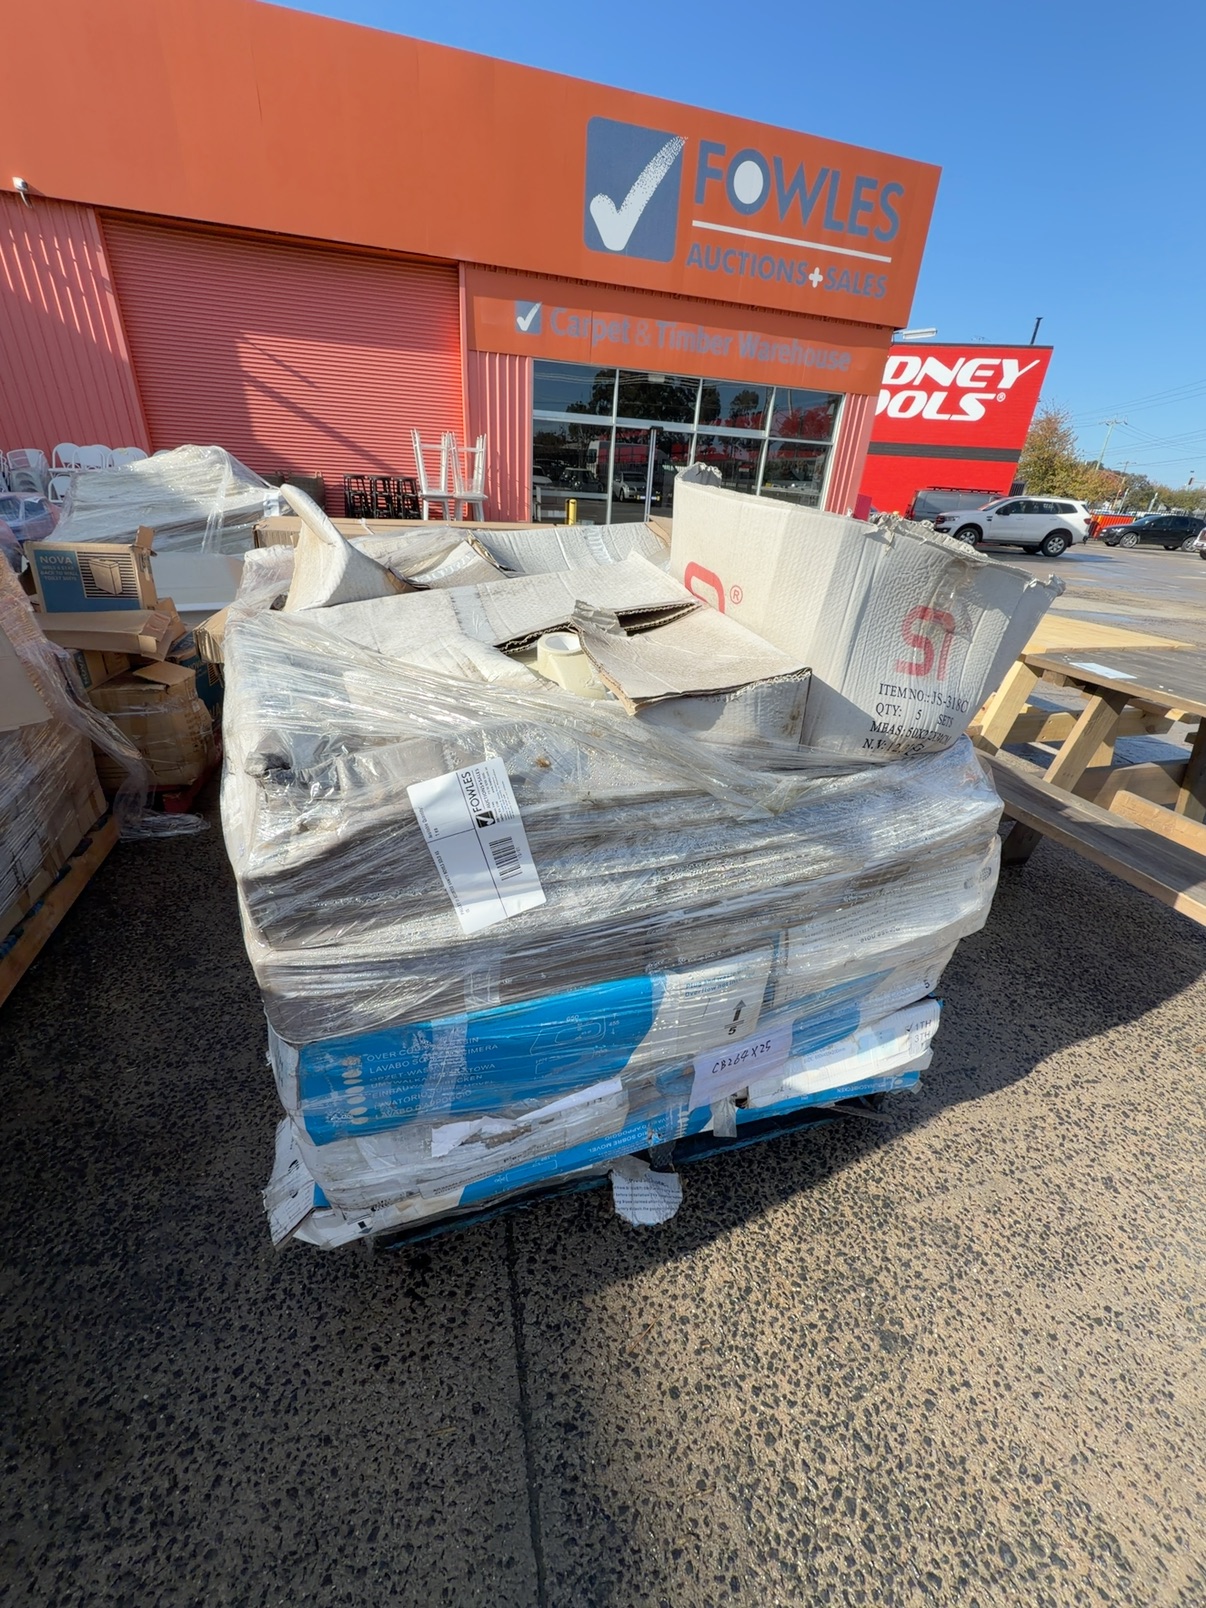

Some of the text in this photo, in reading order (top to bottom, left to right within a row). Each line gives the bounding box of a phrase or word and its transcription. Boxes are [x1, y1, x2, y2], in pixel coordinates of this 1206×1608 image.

[694, 139, 905, 243] FOWLES
[550, 307, 852, 372] Carpet & Timber Warehouse
[881, 354, 1041, 390] DNEY
[39, 555, 74, 566] NOVA
[879, 683, 907, 699] ITEM
[875, 702, 902, 717] QTY:
[916, 709, 922, 720] 5
[461, 771, 482, 813] FOWLES
[684, 986, 717, 997] Overflow
[728, 1027, 737, 1035] 5
[366, 1050, 397, 1063] OVER
[369, 1060, 410, 1074] LAVABO
[612, 1135, 636, 1146] SOBRE
